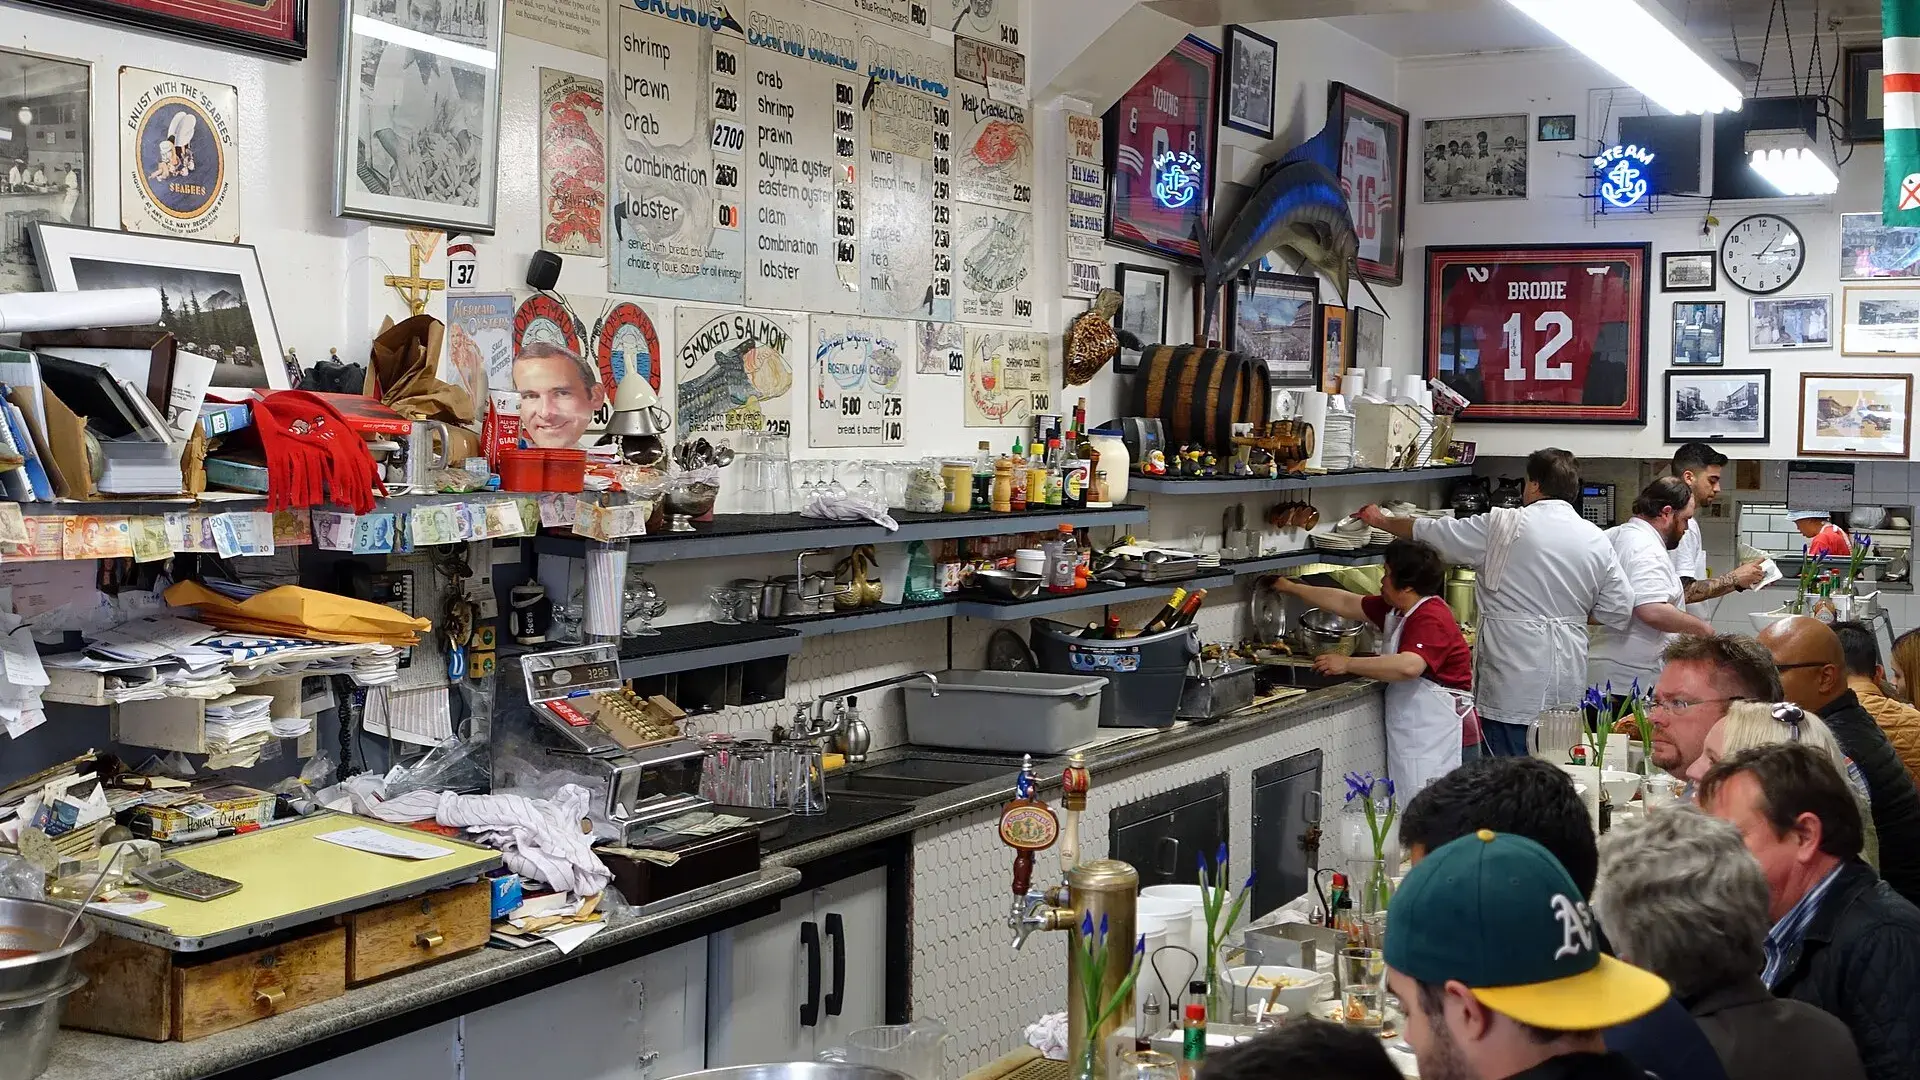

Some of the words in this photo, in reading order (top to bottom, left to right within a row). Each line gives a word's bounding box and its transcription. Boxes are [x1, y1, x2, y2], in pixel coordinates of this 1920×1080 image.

[747, 10, 807, 57] SEAFOOD
[624, 32, 670, 70] shrimp
[995, 48, 1020, 73] Charge
[624, 74, 670, 101] prawn
[756, 70, 784, 90] crab
[128, 91, 152, 131] ENLIST
[153, 82, 178, 98] WITH
[180, 82, 198, 98] THE
[758, 95, 795, 125] shrimp
[960, 92, 979, 124] Half
[980, 100, 1008, 120] Cracked
[1009, 107, 1025, 124] Crab
[1152, 84, 1179, 118] YOUNG
[624, 112, 660, 135] crab
[1130, 107, 1138, 134] 8
[713, 124, 744, 150] 2700
[758, 125, 793, 148] prawn
[1188, 130, 1196, 154] 8
[870, 149, 892, 164] wine
[934, 156, 950, 176] 900
[1594, 144, 1655, 169] STEAM
[624, 154, 707, 186] combination
[758, 151, 798, 179] olympia
[802, 160, 833, 184] oyster
[1071, 164, 1100, 184] MIYAGI
[132, 170, 146, 200] INQUIRE
[146, 202, 152, 210] AT
[152, 209, 162, 219] ANY
[164, 218, 174, 227] U.S.
[192, 206, 218, 227] RECRUITING
[218, 182, 229, 206] STATION
[168, 182, 206, 196] SEABEES
[758, 178, 799, 198] eastern
[802, 188, 833, 208] oyster
[934, 181, 950, 200] 250
[626, 192, 678, 222] lobster
[758, 206, 786, 226] clam
[934, 206, 950, 224] 250
[1356, 174, 1376, 240] 16
[1069, 214, 1085, 228] BLUE
[1084, 215, 1102, 232] POINT
[1742, 224, 1751, 232] 11
[1758, 219, 1768, 228] 12
[1776, 224, 1780, 232] 1
[758, 234, 818, 256] combination
[934, 230, 950, 248] 250
[1730, 236, 1740, 244] 10
[628, 238, 650, 251] served
[651, 241, 666, 253] with
[668, 240, 689, 256] bread
[690, 247, 702, 258] and
[704, 246, 726, 260] butter
[871, 250, 889, 266] tea
[1728, 250, 1734, 259] 9
[628, 254, 650, 271] choice
[760, 258, 800, 280] lobster
[934, 254, 950, 273] 250
[1732, 266, 1738, 274] 8
[1786, 264, 1792, 272] 4
[457, 264, 474, 284] 37
[870, 275, 892, 292] milk
[1742, 276, 1746, 284] 7
[1776, 276, 1781, 284] 5
[934, 278, 950, 296] 250
[1508, 281, 1567, 300] BRODIE
[1759, 280, 1764, 288] 6
[468, 316, 510, 336] OYSTERS
[492, 338, 504, 353] SALT
[682, 320, 730, 368] SMOKED
[734, 316, 787, 354] SALMON
[1008, 334, 1030, 352] special
[1502, 310, 1573, 381] 12
[490, 357, 511, 377] OYSTERS
[828, 364, 850, 374] BOSTON
[852, 364, 866, 374] CLAM
[820, 400, 836, 410] bowl
[842, 397, 860, 416] 500
[868, 400, 882, 416] cup
[1031, 394, 1048, 410] 1300
[689, 412, 716, 423] served
[716, 414, 724, 422] on
[742, 412, 762, 423] french
[689, 422, 708, 433] bread
[711, 423, 724, 432] with
[838, 425, 856, 435] bread
[862, 426, 882, 435] butter
[64, 520, 76, 535] 20
[186, 524, 191, 534] 5
[210, 518, 222, 528] 20
[360, 532, 368, 546] 5
[187, 816, 215, 833] Holiday
